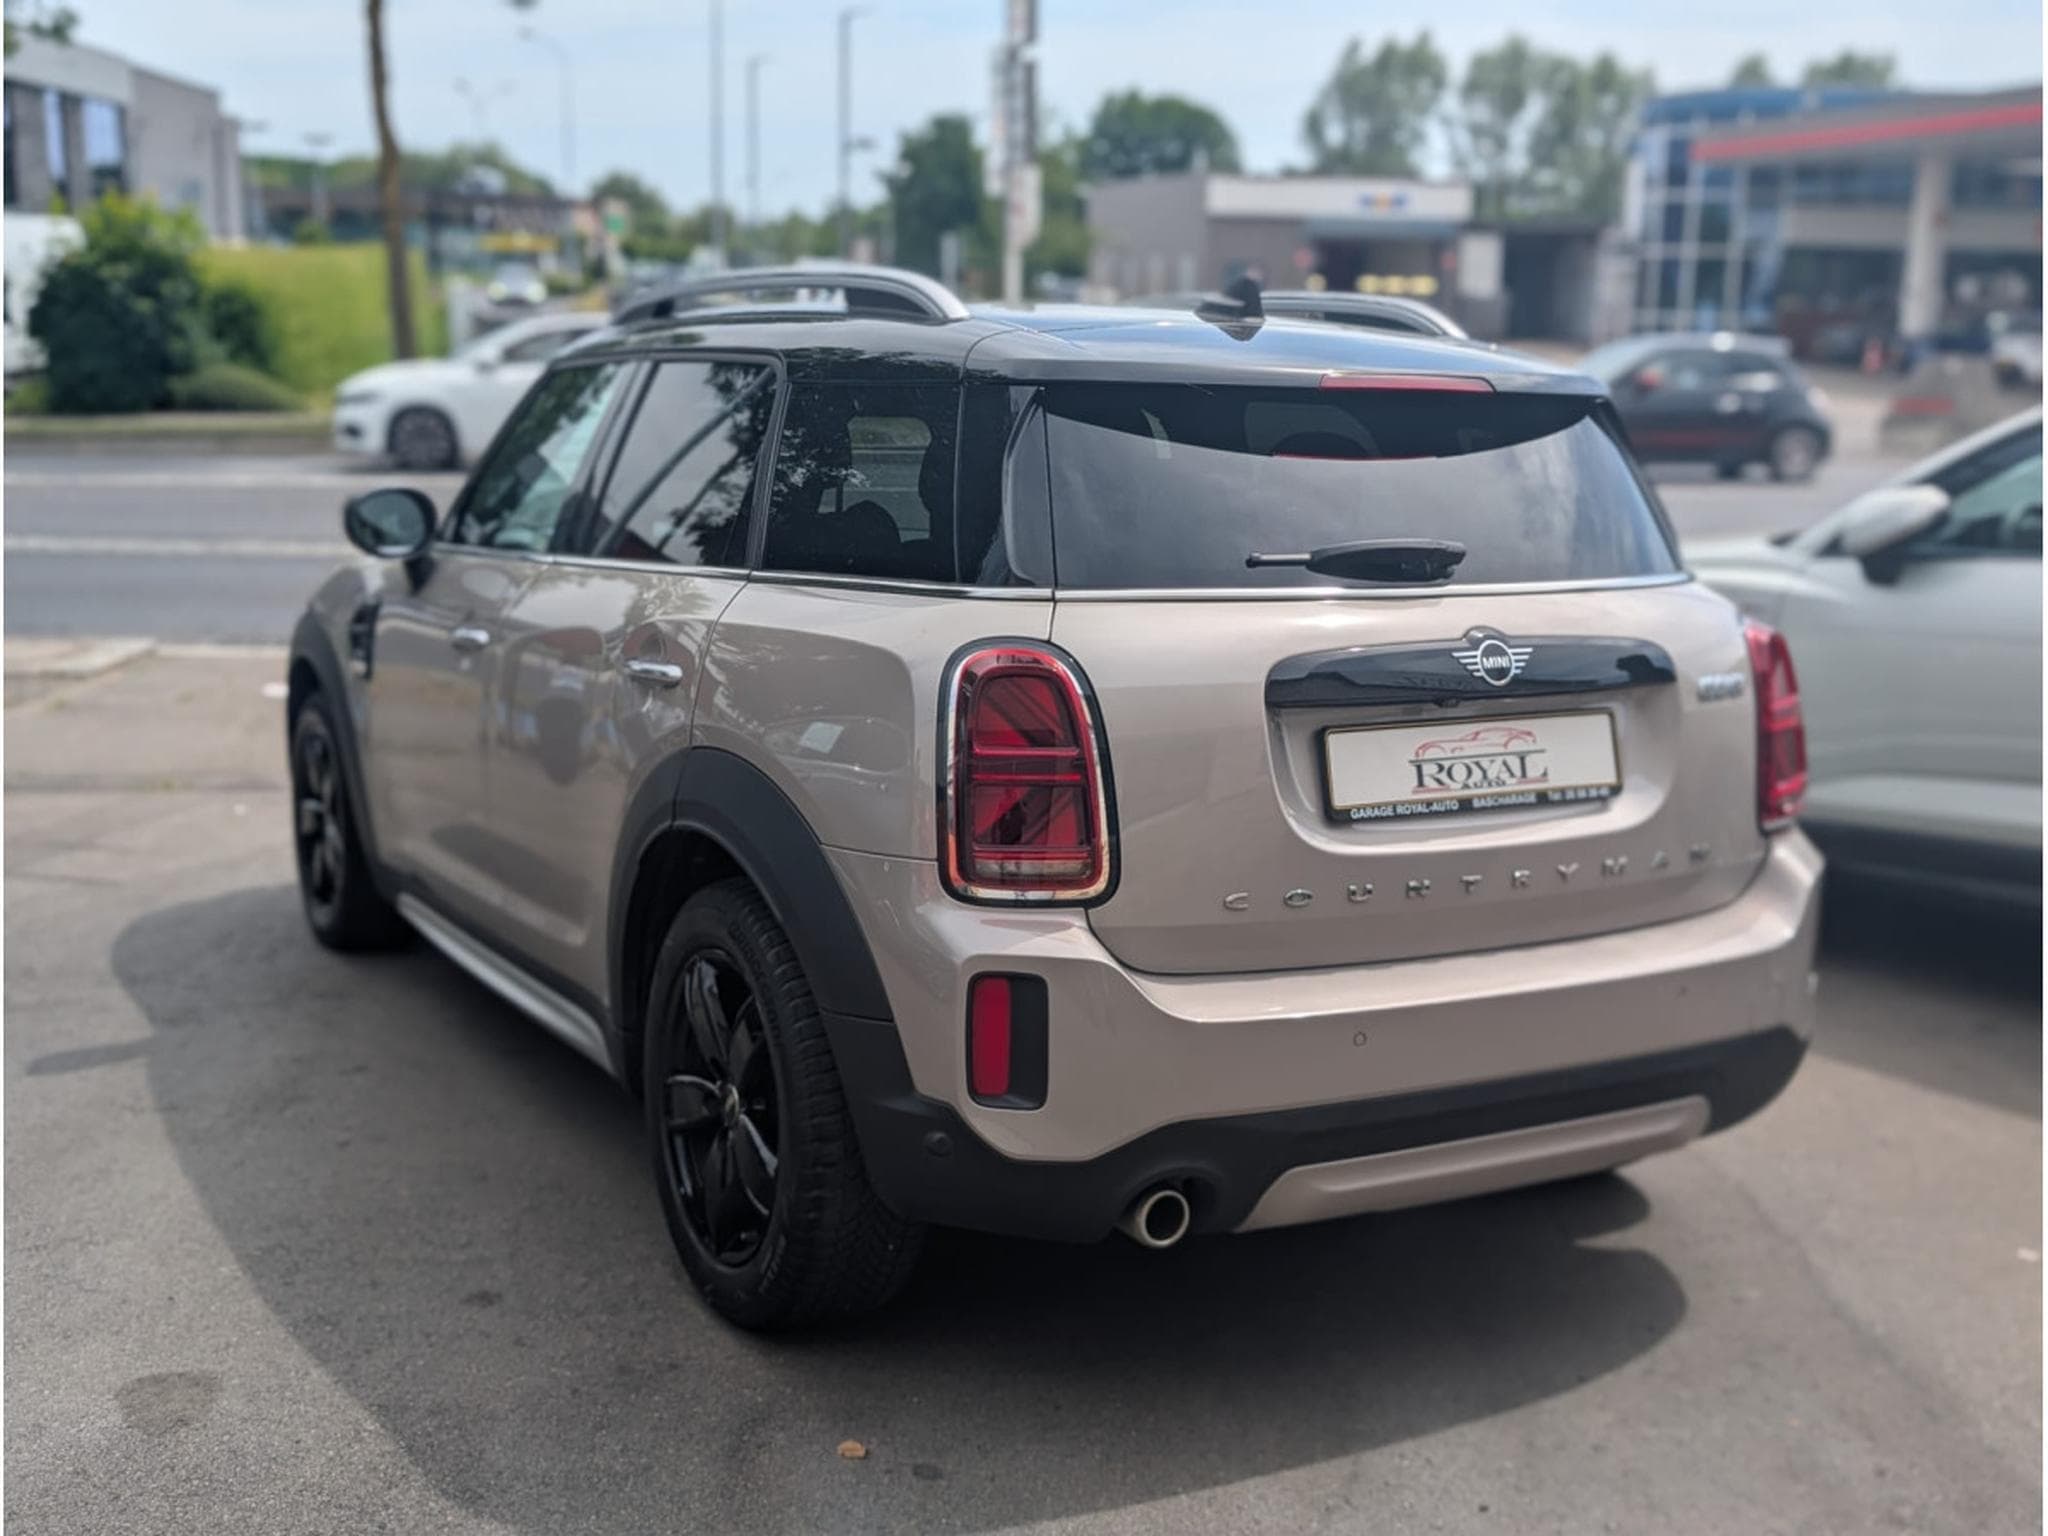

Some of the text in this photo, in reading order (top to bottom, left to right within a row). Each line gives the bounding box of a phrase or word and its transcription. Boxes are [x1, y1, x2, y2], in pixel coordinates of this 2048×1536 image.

[1482, 655, 1510, 669] MINI
[1412, 754, 1548, 788] ROYAL
[1350, 806, 1394, 819] GARAGE
[1396, 801, 1459, 815] ROYAL-AUTO
